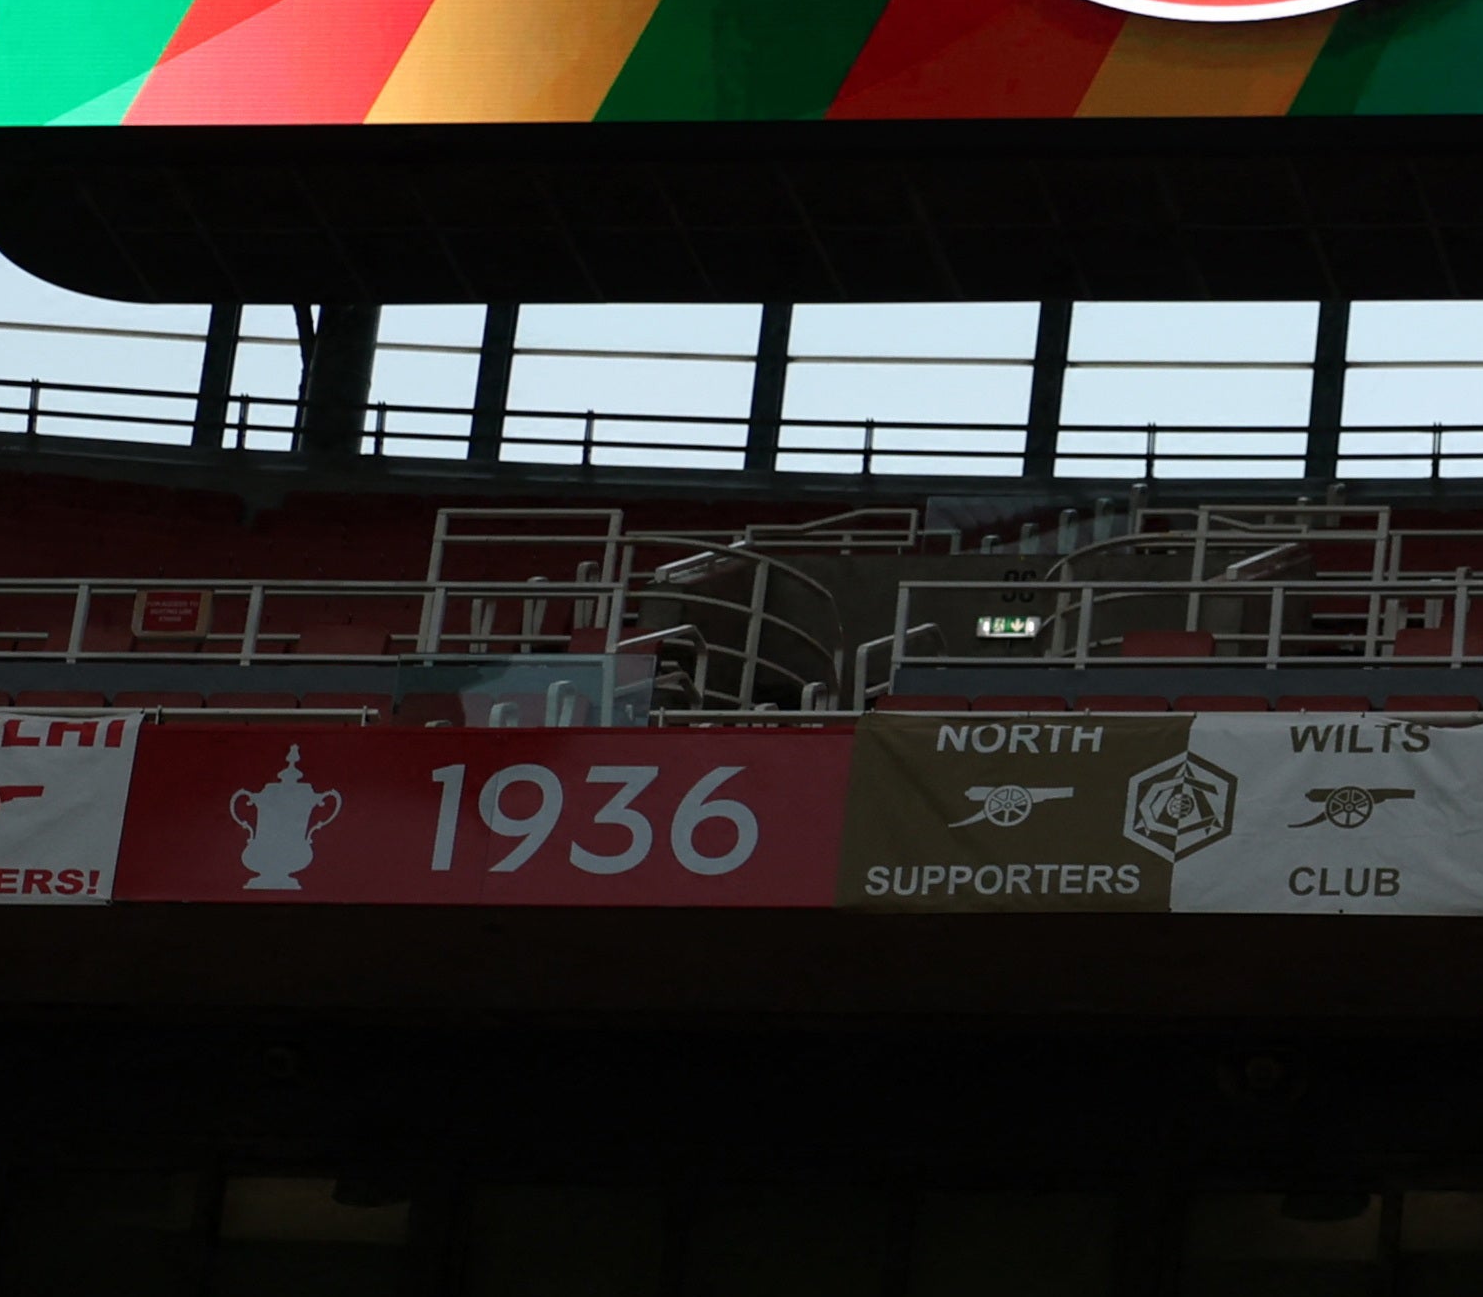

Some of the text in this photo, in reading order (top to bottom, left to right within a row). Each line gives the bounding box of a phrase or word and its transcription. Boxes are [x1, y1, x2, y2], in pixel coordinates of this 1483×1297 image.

[936, 722, 1430, 754] NORTH WILTS
[431, 763, 760, 876] 1936
[864, 863, 1401, 897] SUPPORTERS CLUB
